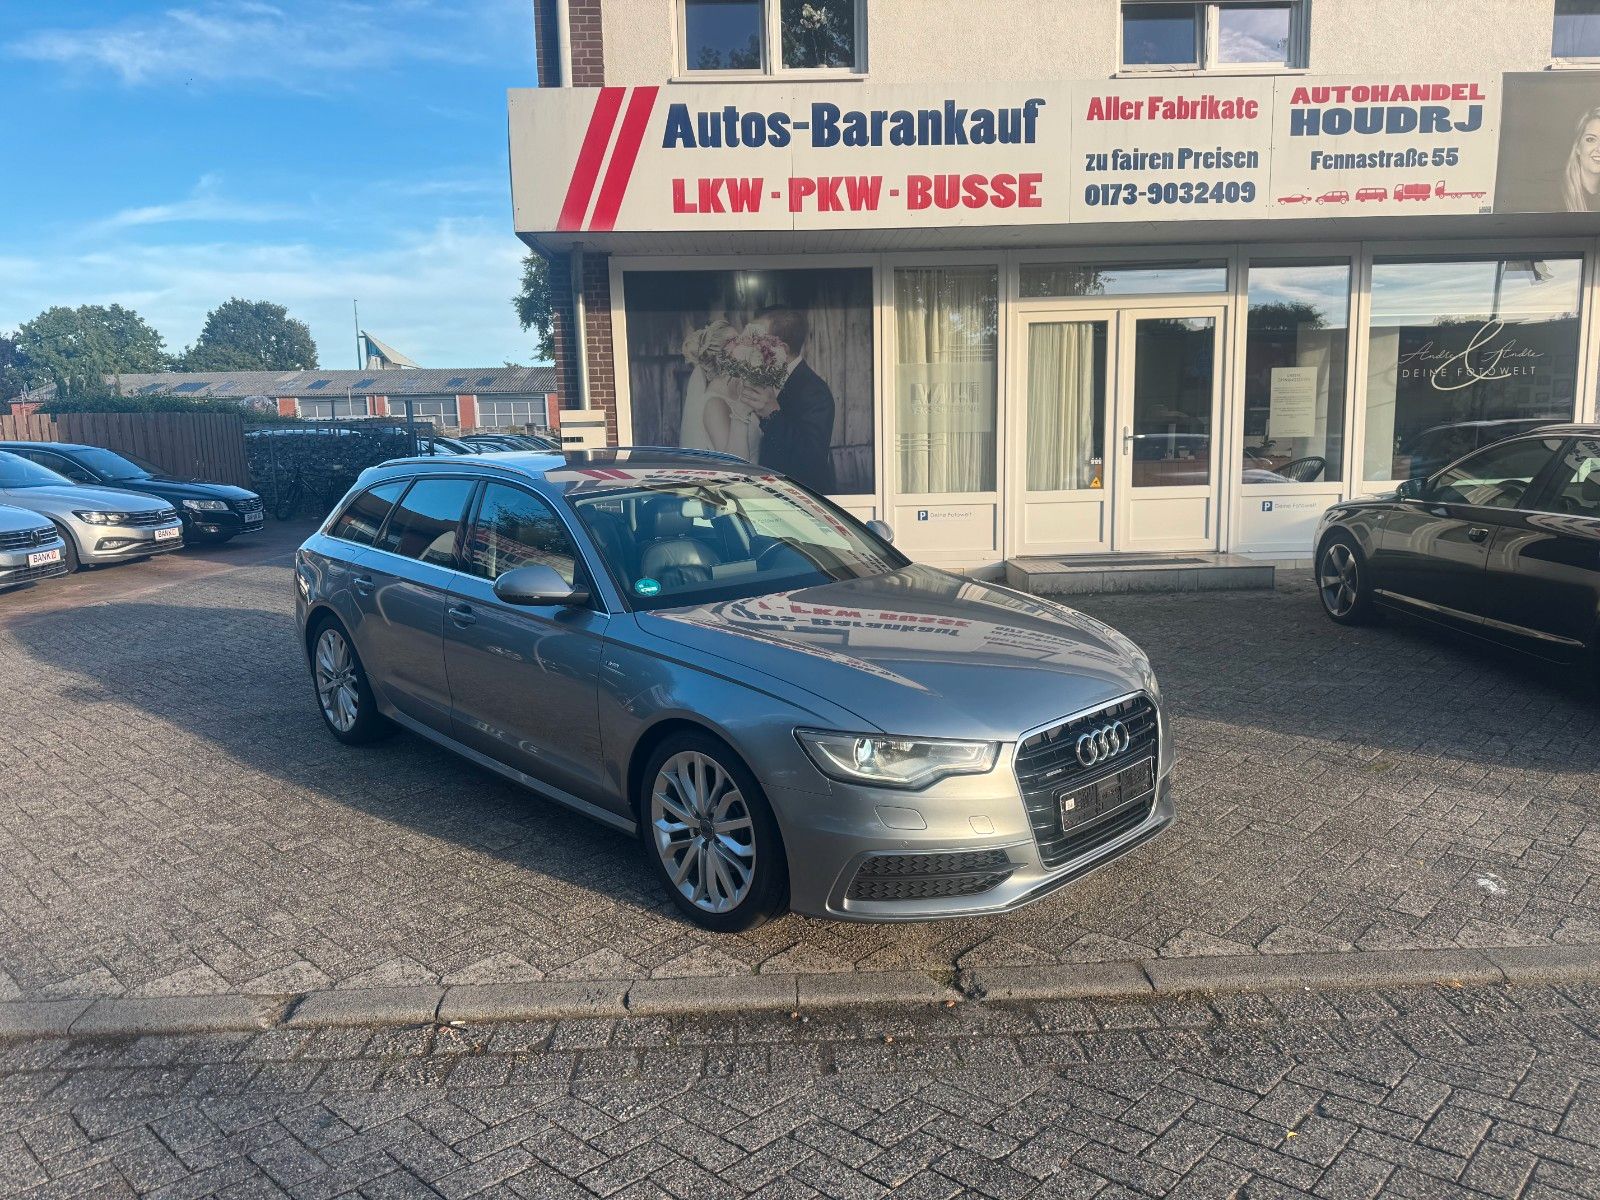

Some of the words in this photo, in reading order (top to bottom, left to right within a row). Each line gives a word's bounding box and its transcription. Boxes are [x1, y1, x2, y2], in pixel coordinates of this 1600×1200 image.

[1290, 83, 1485, 104] AUTOHANDEL
[1086, 96, 1143, 120] Aller
[1147, 95, 1258, 120] Fabrikate
[662, 98, 1046, 148] Autos-Barankauf
[1290, 105, 1483, 136] HOUDRJ
[1085, 153, 1107, 171] zu
[1111, 148, 1174, 170] fairen
[1177, 147, 1258, 169] Preisen
[1310, 148, 1428, 170] Fennastraße
[1431, 147, 1459, 166] 55
[672, 177, 764, 213] LKW
[788, 176, 883, 212] PKW
[907, 173, 1043, 210] BUSSE
[1084, 181, 1256, 206] 0173-9032409
[1402, 368, 1447, 378] DEINE
[1457, 366, 1536, 377] FOTOWELT
